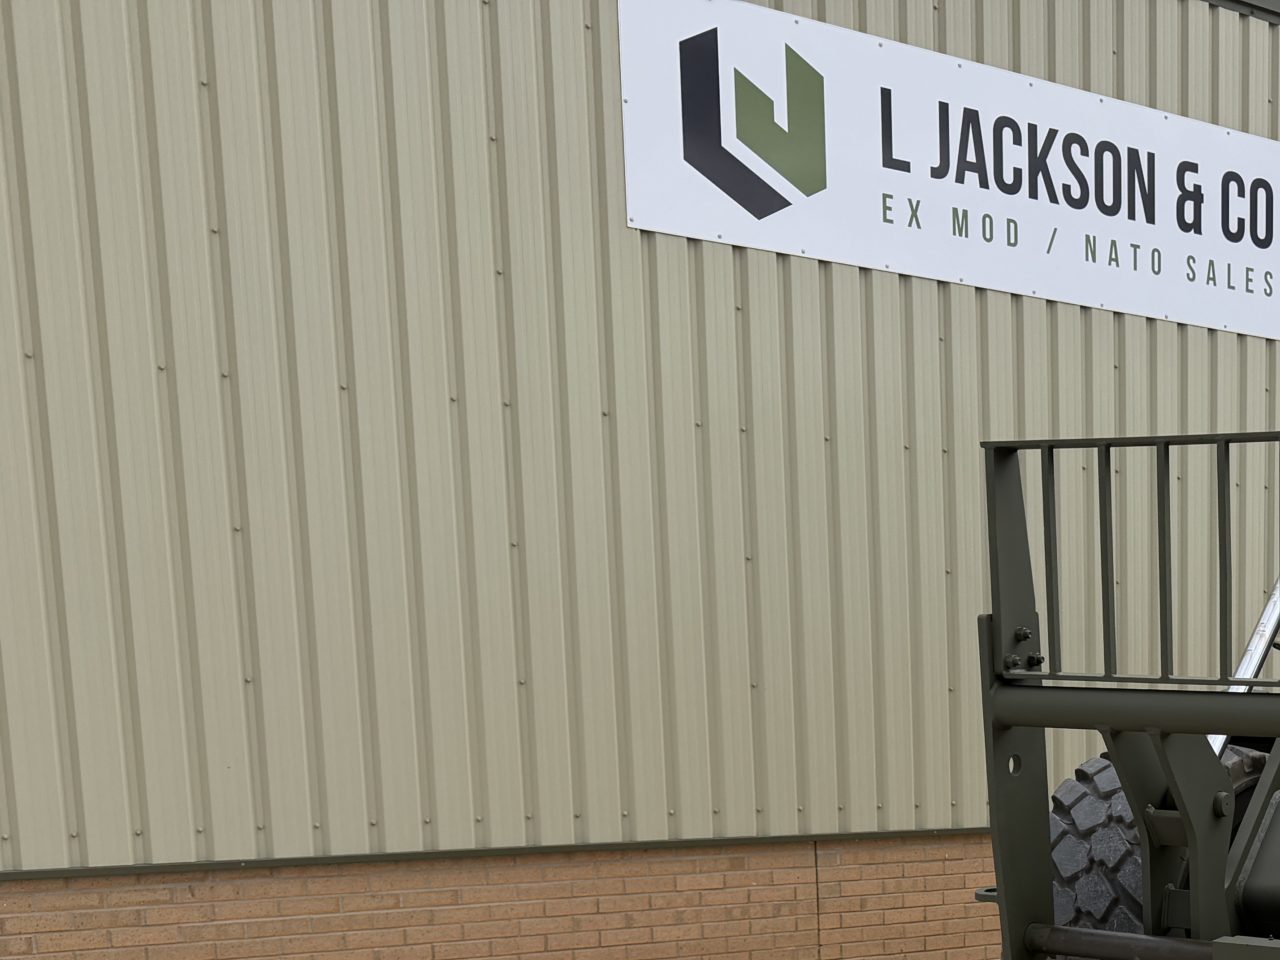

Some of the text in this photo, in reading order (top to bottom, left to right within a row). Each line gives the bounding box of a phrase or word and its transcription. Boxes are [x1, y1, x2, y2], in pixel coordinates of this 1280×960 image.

[879, 86, 912, 174] L
[929, 100, 1156, 226] JACKSON
[1175, 160, 1205, 236] &
[1220, 170, 1274, 250] CO
[881, 192, 1274, 298] EX MOD / NATO SALES
